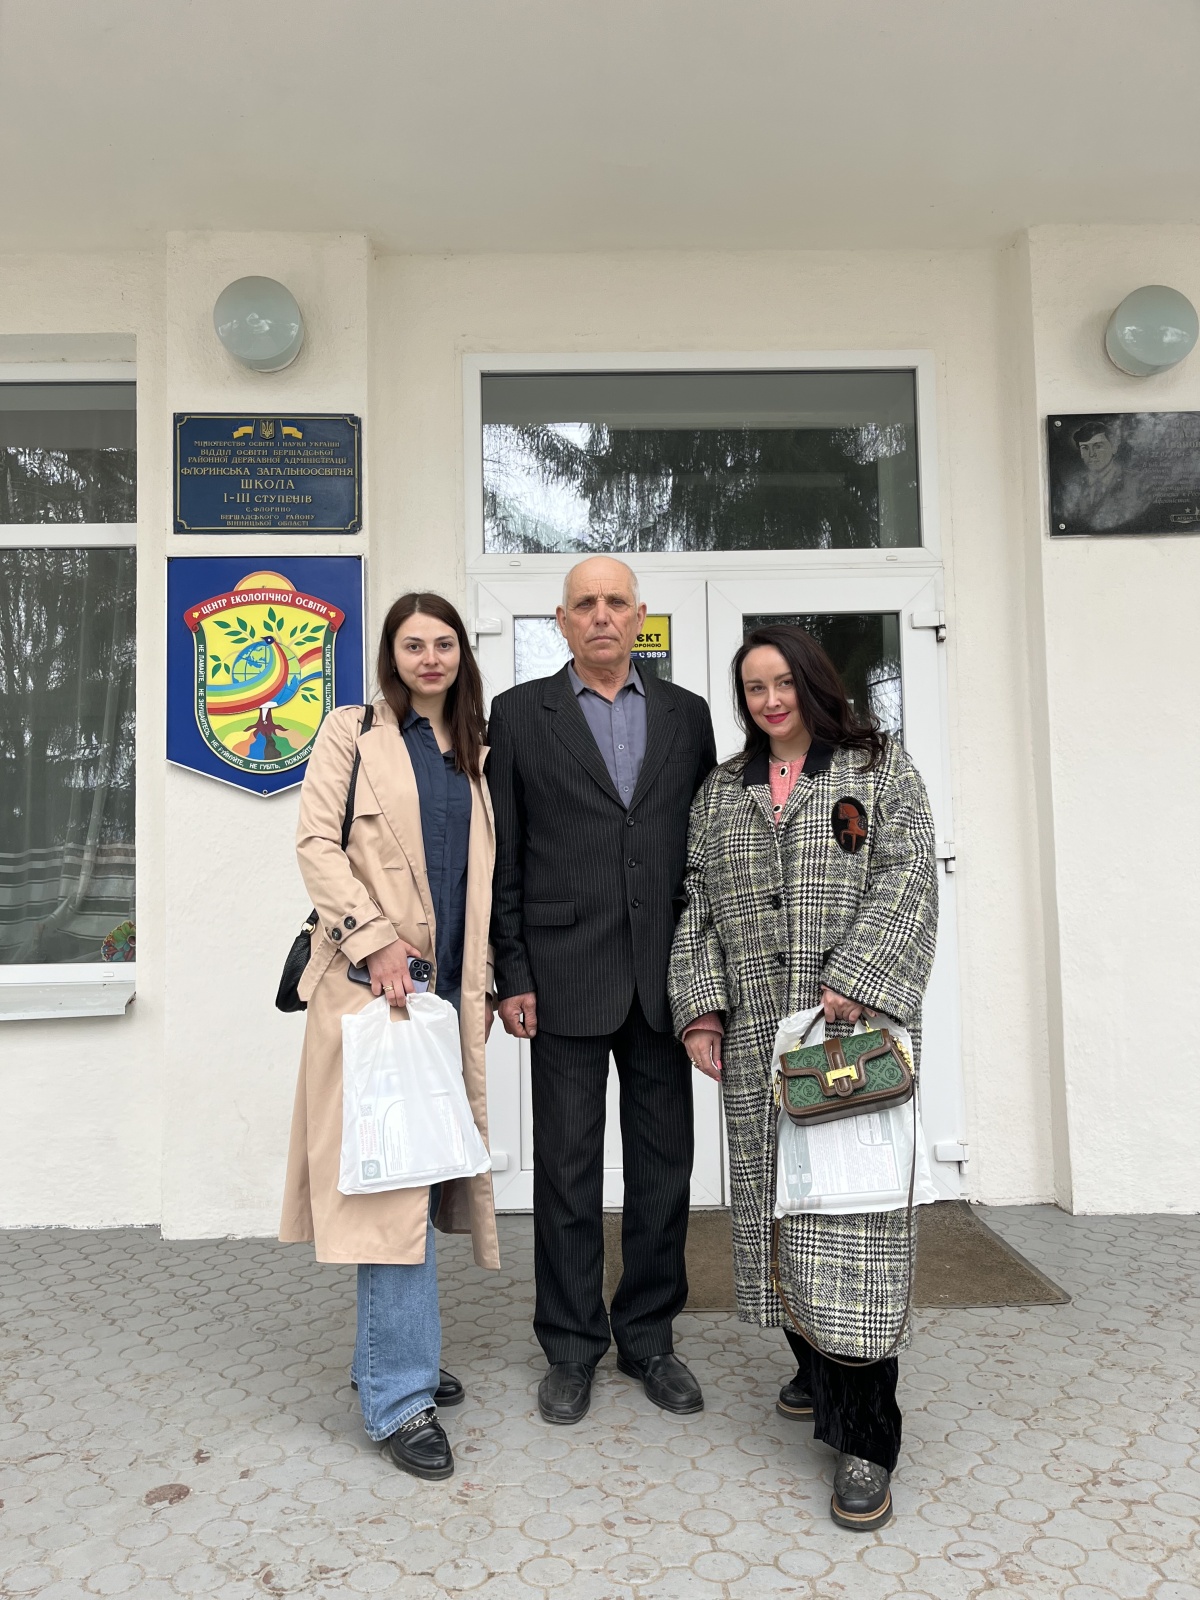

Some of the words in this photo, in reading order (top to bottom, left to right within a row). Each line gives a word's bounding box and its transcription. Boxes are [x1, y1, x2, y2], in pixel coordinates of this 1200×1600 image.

[273, 449, 334, 457] БЕРШАДСЬКОЇ
[231, 456, 281, 464] ДЕРЖАВНОЇ
[283, 457, 347, 465] АДМІНІСТРАЦІЇ
[180, 467, 251, 476] ФЛОРИНСЬКА
[256, 467, 354, 476] ЗАГАЛЬНООСВІТНЯ
[240, 479, 296, 490] ШКОЛА
[254, 494, 313, 504] СТУПЕНІВ
[200, 598, 228, 615] ЦЕНТР
[230, 592, 293, 605] ЕКОЛОГІЧНОЇ
[295, 597, 328, 614] ОСВІТИ
[636, 633, 662, 643] ЄКТ
[198, 644, 205, 653] НЕ
[198, 654, 206, 684] ЛАМАЙТЕ,
[198, 688, 205, 697] НЕ
[210, 739, 220, 748] НЕ
[249, 762, 258, 770] НЕ
